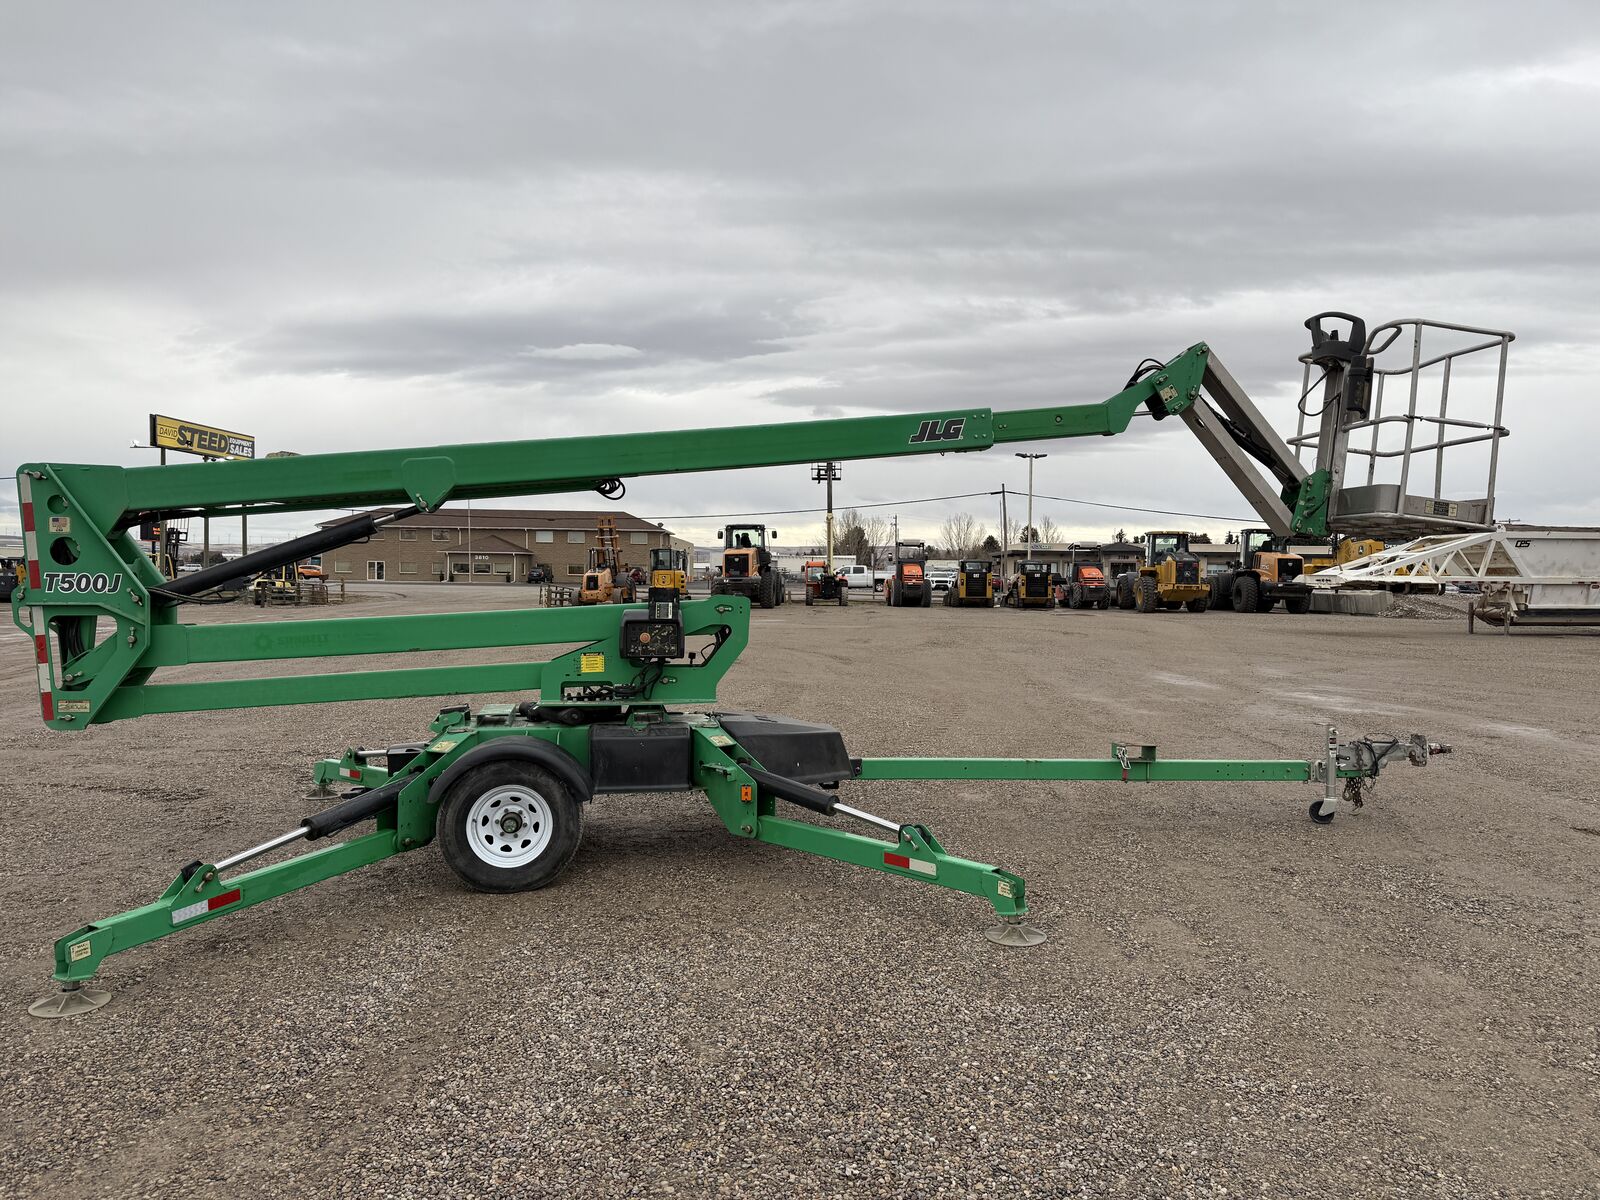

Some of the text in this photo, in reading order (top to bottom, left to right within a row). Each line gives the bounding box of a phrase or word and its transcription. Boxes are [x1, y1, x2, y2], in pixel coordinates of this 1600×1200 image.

[159, 425, 229, 453] DAVID STEED
[908, 417, 966, 444] JLG
[229, 444, 253, 458] SALES
[44, 572, 123, 594] T500J
